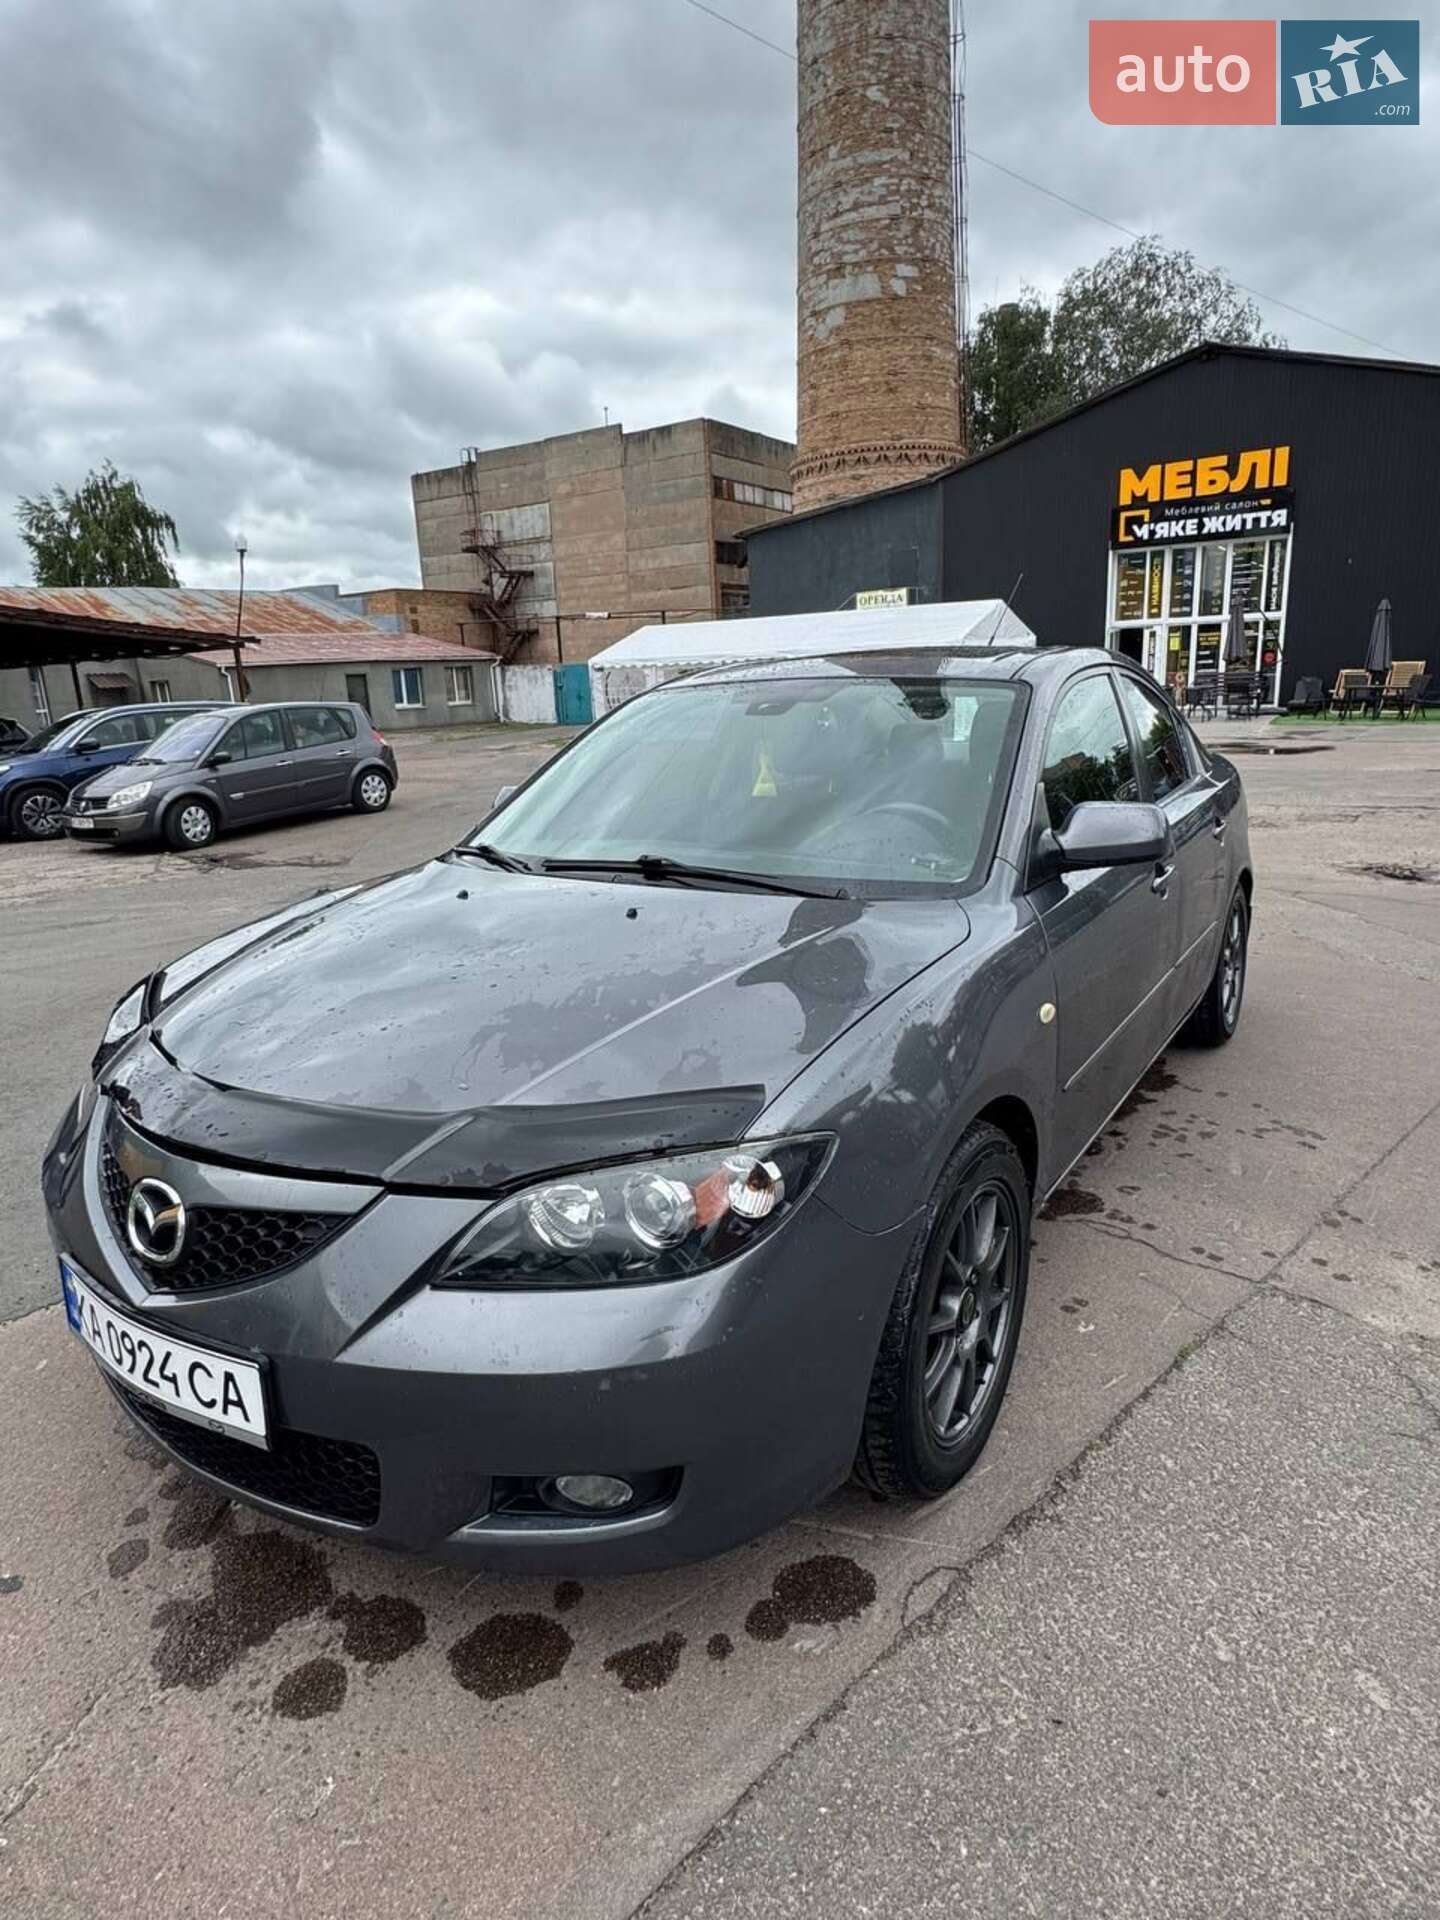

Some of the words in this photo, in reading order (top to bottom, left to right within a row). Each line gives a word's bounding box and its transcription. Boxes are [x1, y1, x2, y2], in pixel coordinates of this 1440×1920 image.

[1119, 446, 1291, 506] МЕБЛІ
[1164, 501, 1221, 517] Меблевий
[1225, 500, 1259, 511] салон
[1201, 508, 1288, 535] ЖИТТЯ
